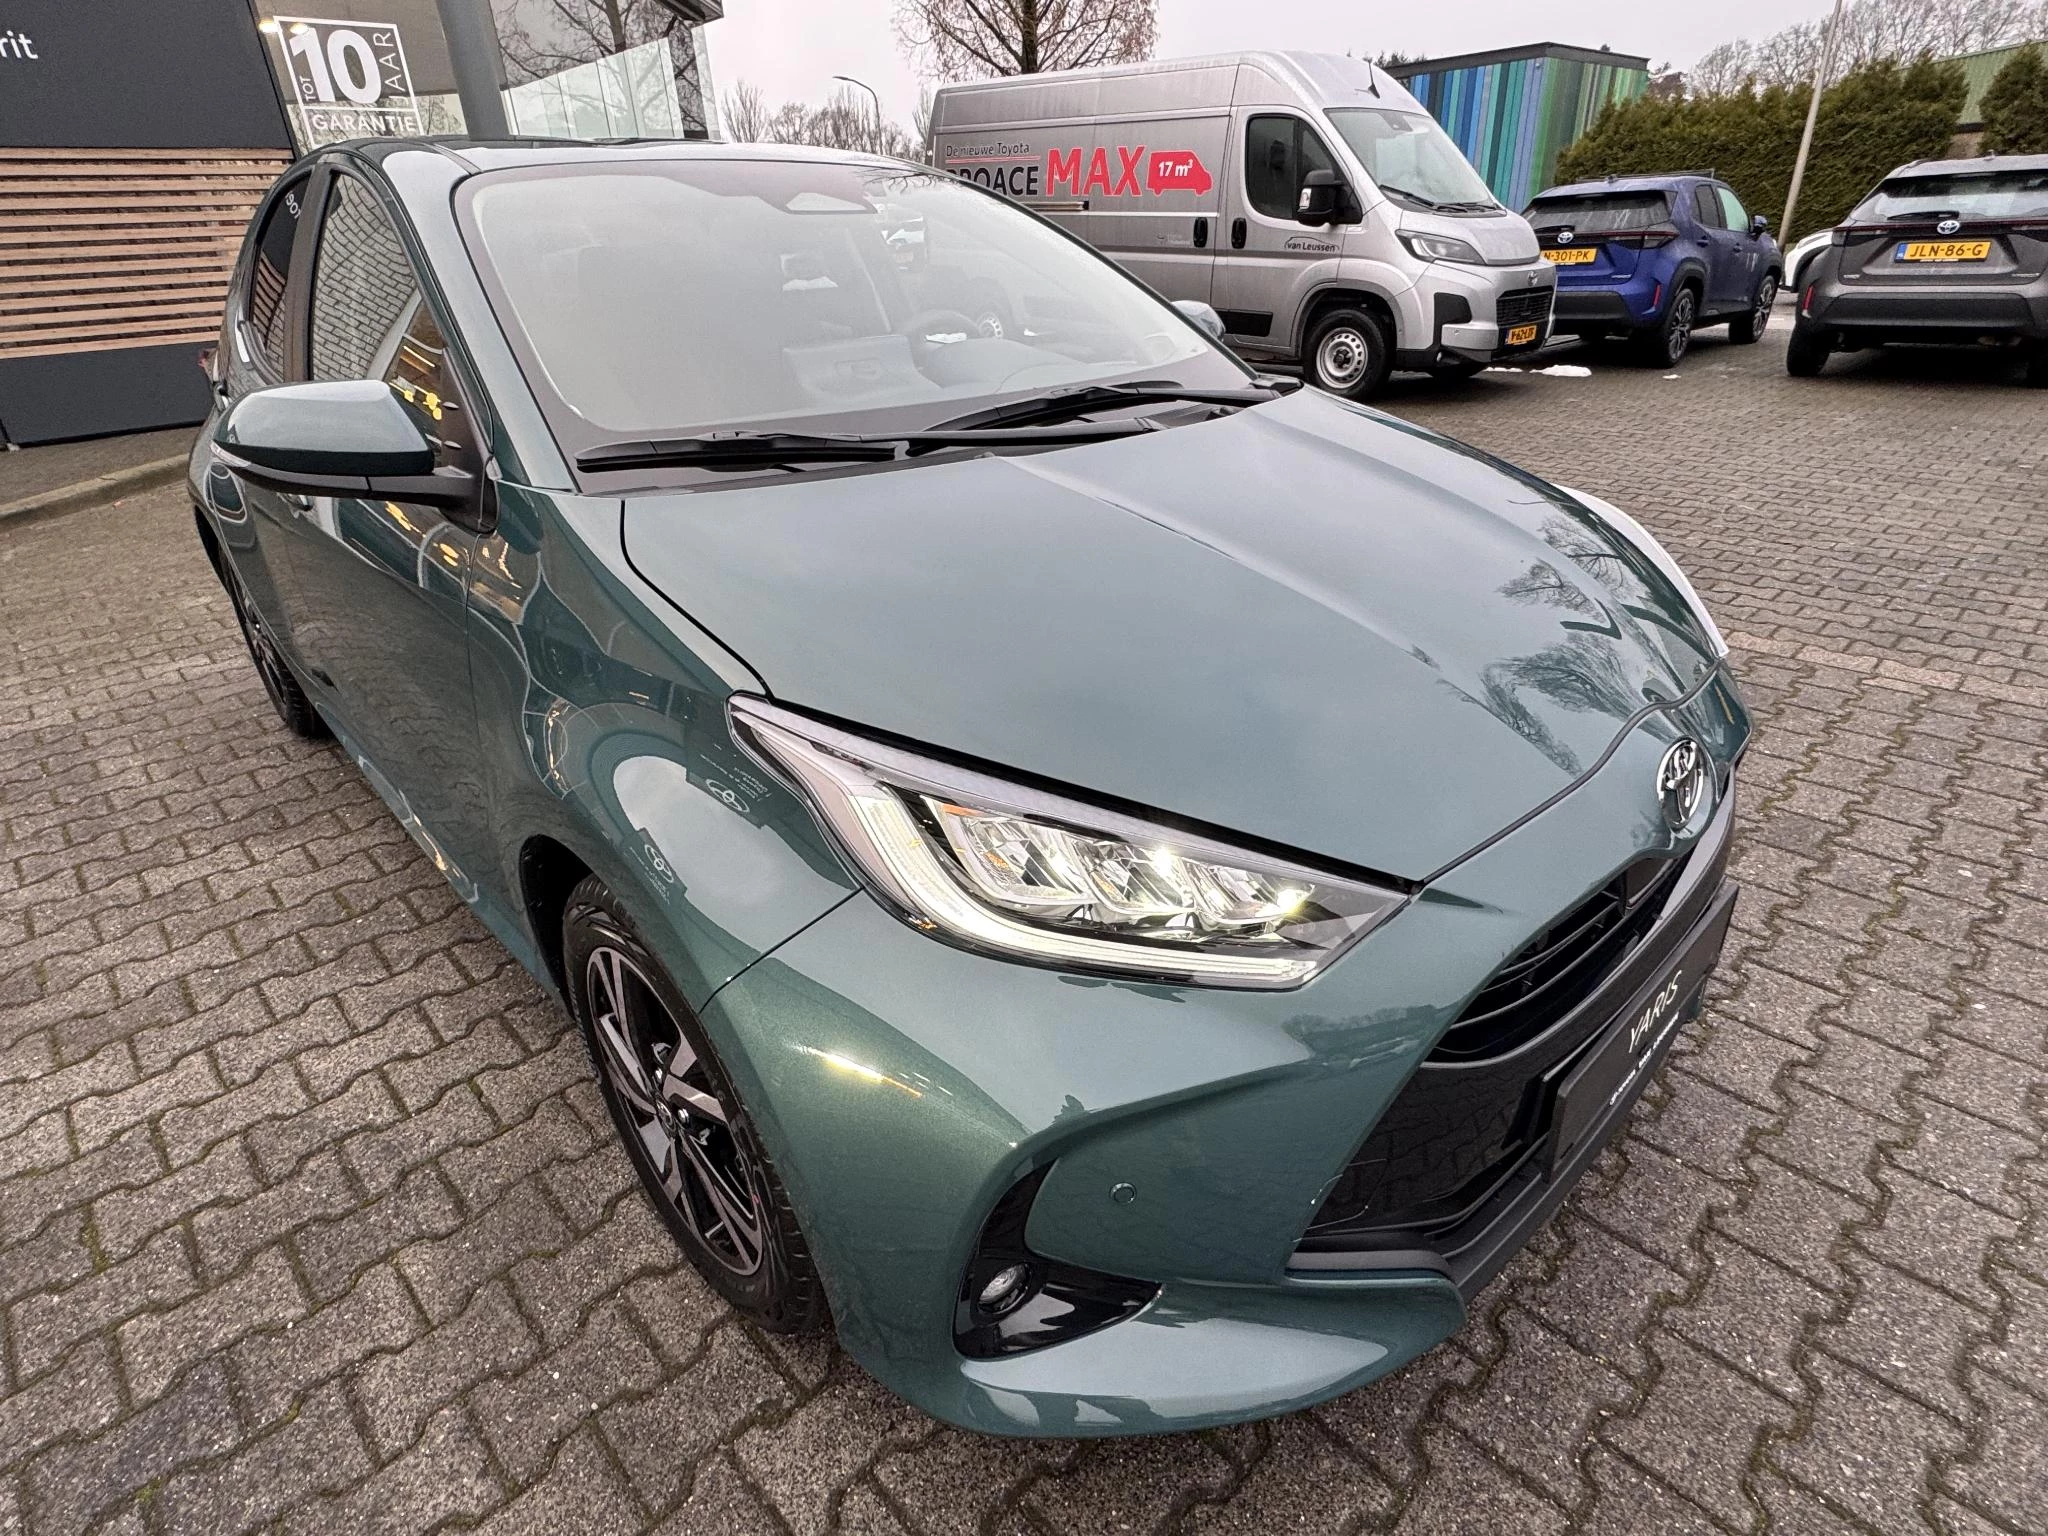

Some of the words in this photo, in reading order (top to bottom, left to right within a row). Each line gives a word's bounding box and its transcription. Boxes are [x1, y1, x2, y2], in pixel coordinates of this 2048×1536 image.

[0, 30, 39, 59] rit
[288, 26, 382, 104] 10
[372, 31, 409, 103] JAAR
[299, 75, 317, 102] TOT
[311, 113, 417, 132] GARANTIE
[946, 145, 959, 157] De
[961, 144, 993, 156] nieuwe
[997, 142, 1030, 157] Toyota
[1046, 145, 1146, 197] MAX
[1158, 160, 1173, 177] 17
[1287, 242, 1301, 250] van
[1302, 241, 1336, 252] Leussen
[1909, 243, 1983, 258] JLN-86-G
[1628, 969, 1682, 1054] YARIS
